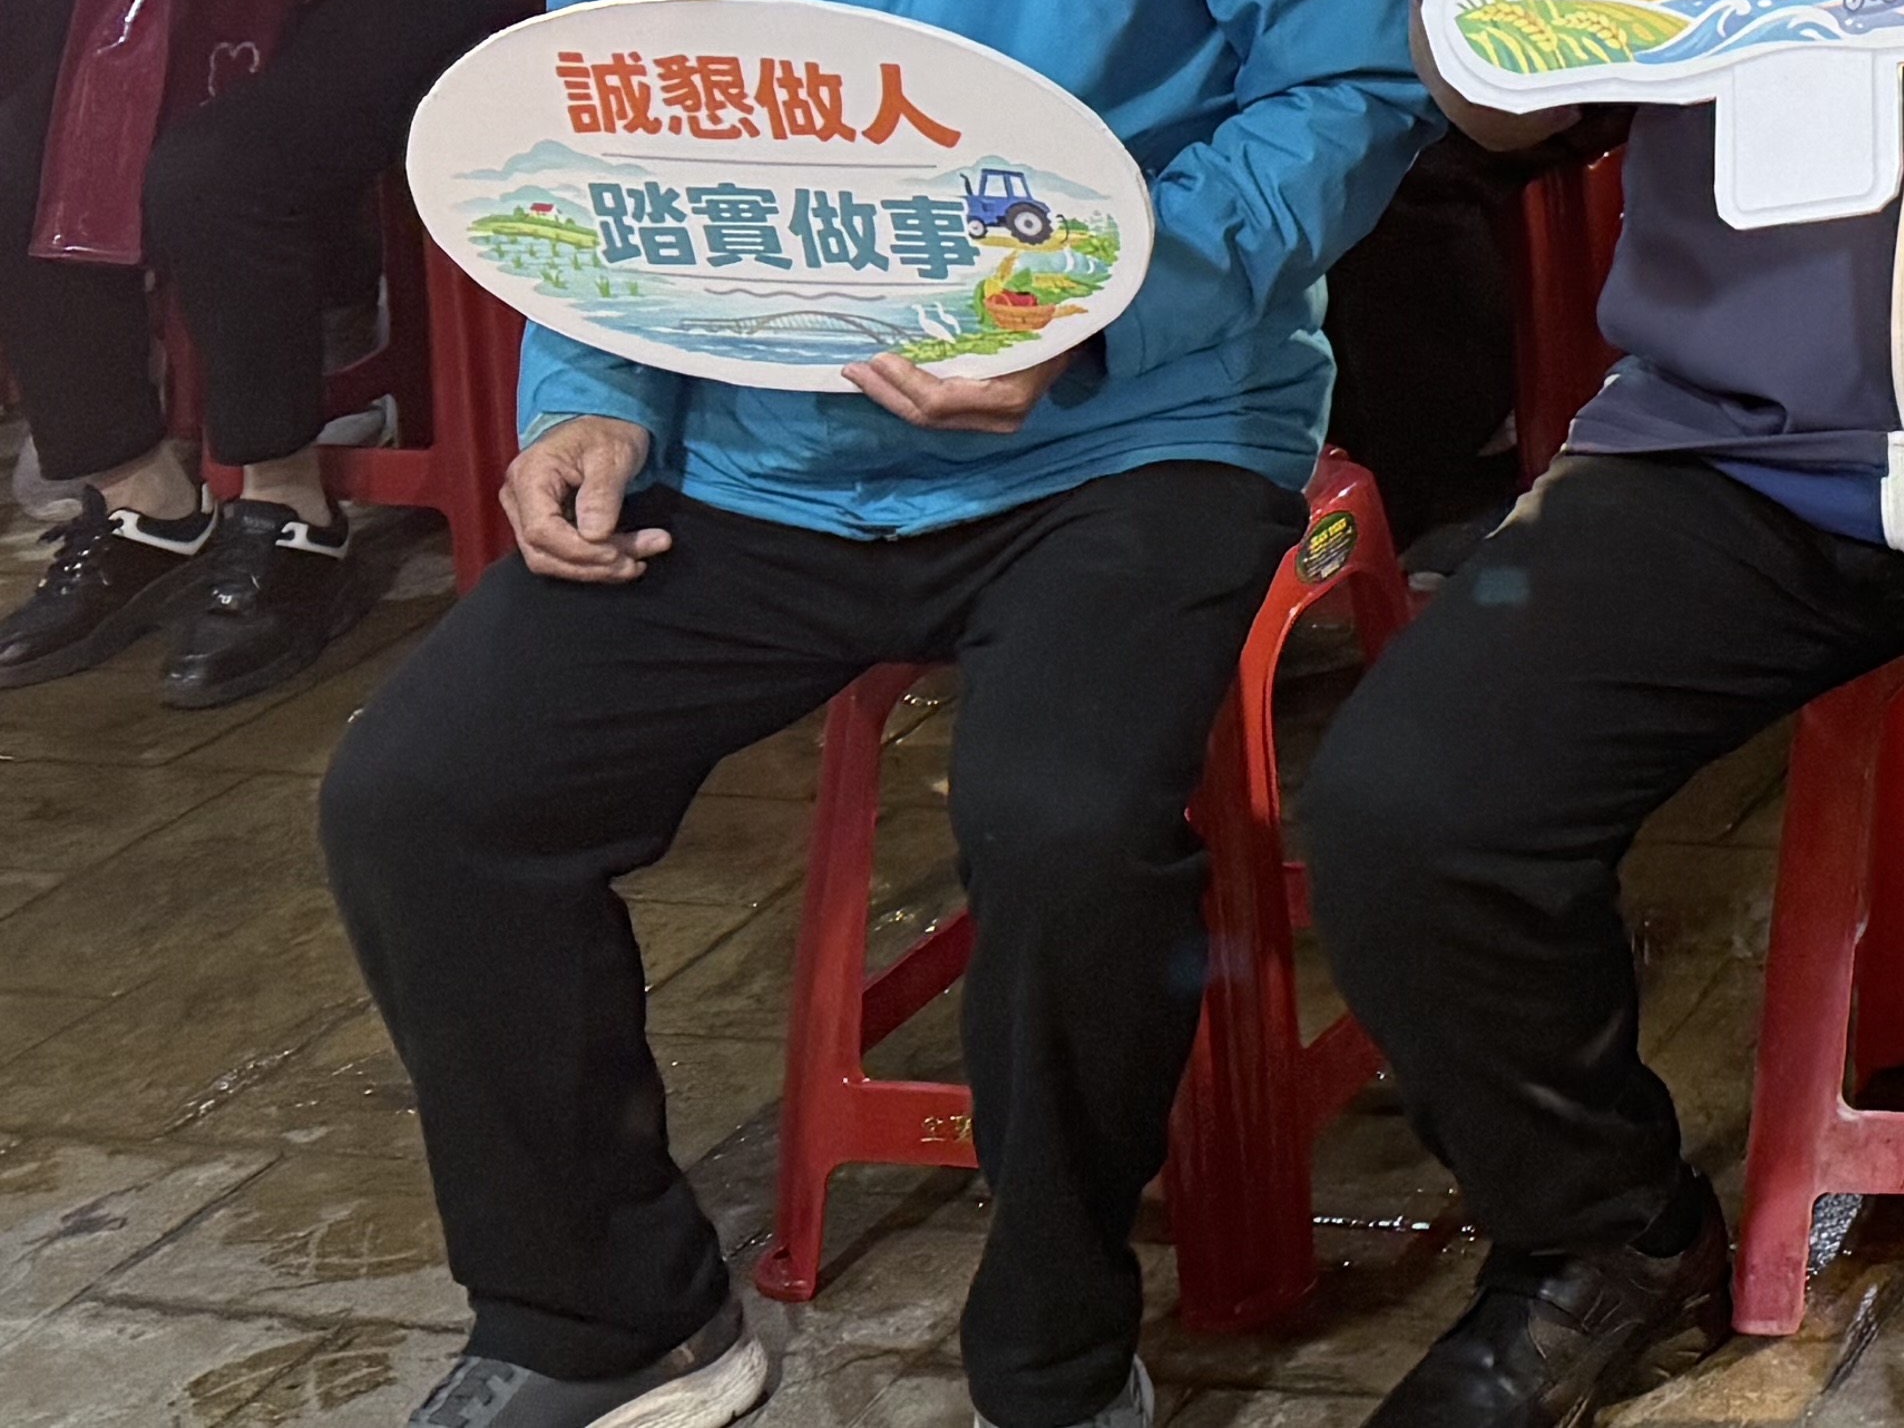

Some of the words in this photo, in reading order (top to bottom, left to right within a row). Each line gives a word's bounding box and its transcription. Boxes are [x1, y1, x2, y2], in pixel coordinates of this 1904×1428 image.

[555, 50, 963, 150] 誠懇做人
[587, 181, 982, 281] 踏實做事
